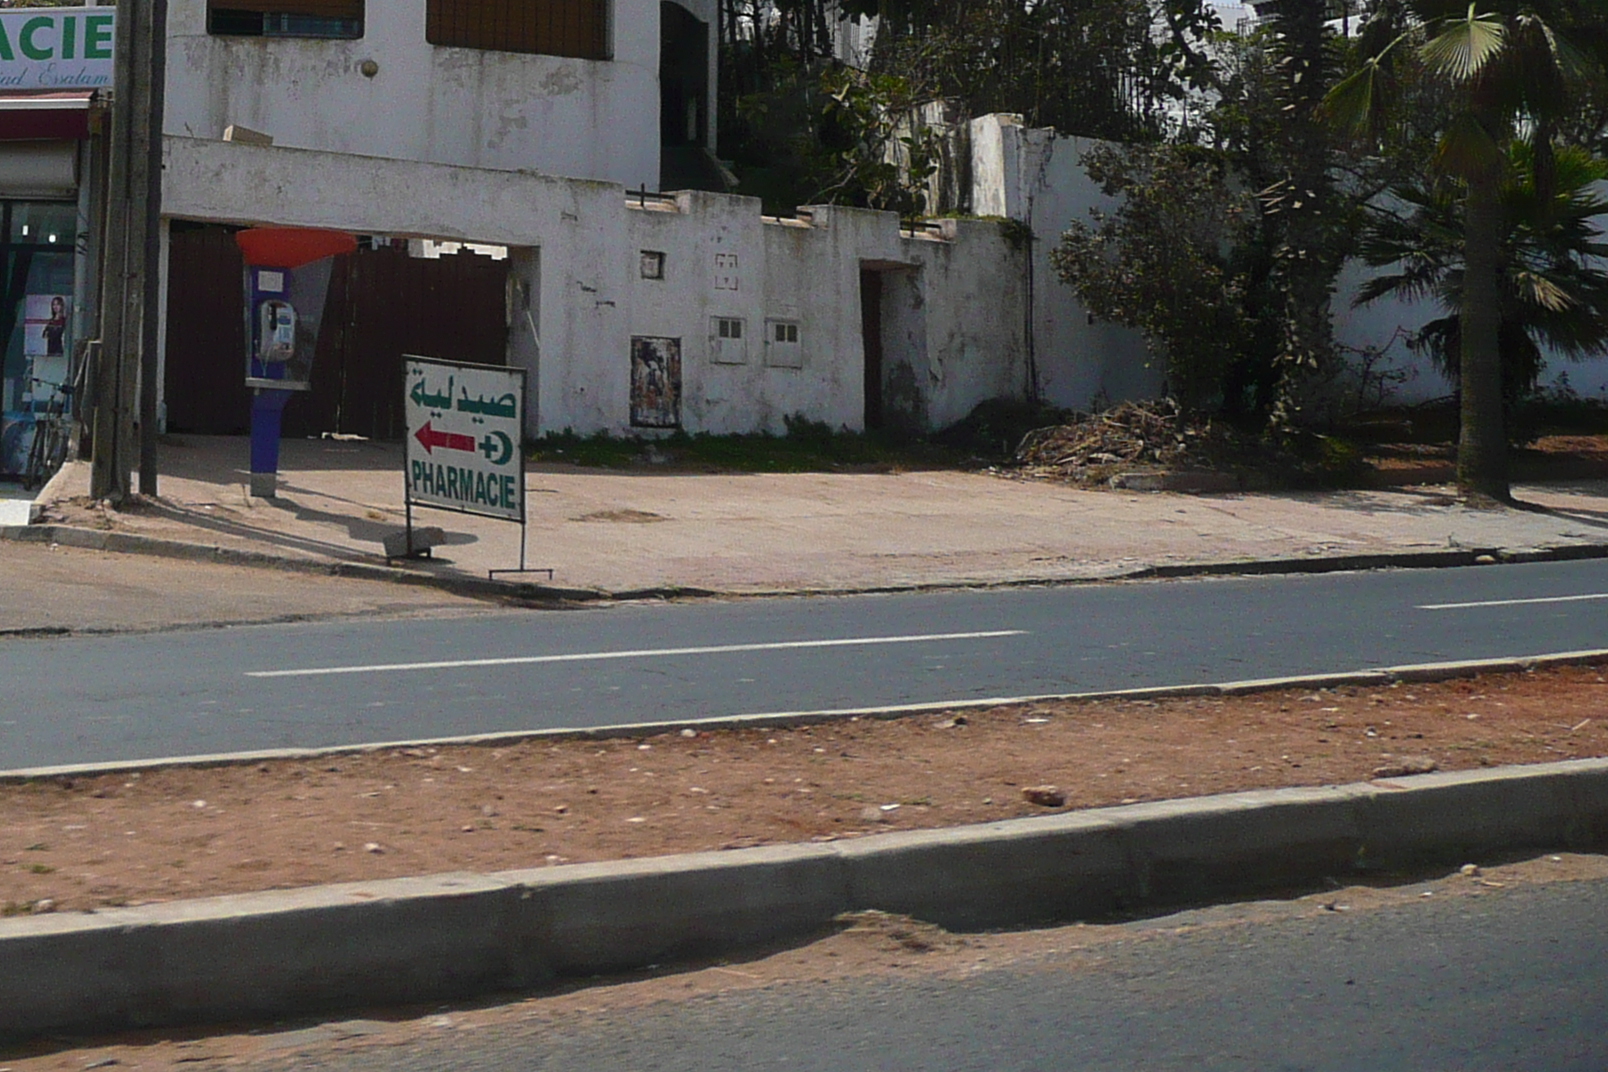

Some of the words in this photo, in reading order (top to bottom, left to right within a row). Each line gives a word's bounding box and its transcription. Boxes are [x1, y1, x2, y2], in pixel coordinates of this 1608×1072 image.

[38, 62, 109, 86] Essalam
[409, 368, 517, 425] صيدلية
[411, 459, 516, 510] PHARMACIE
